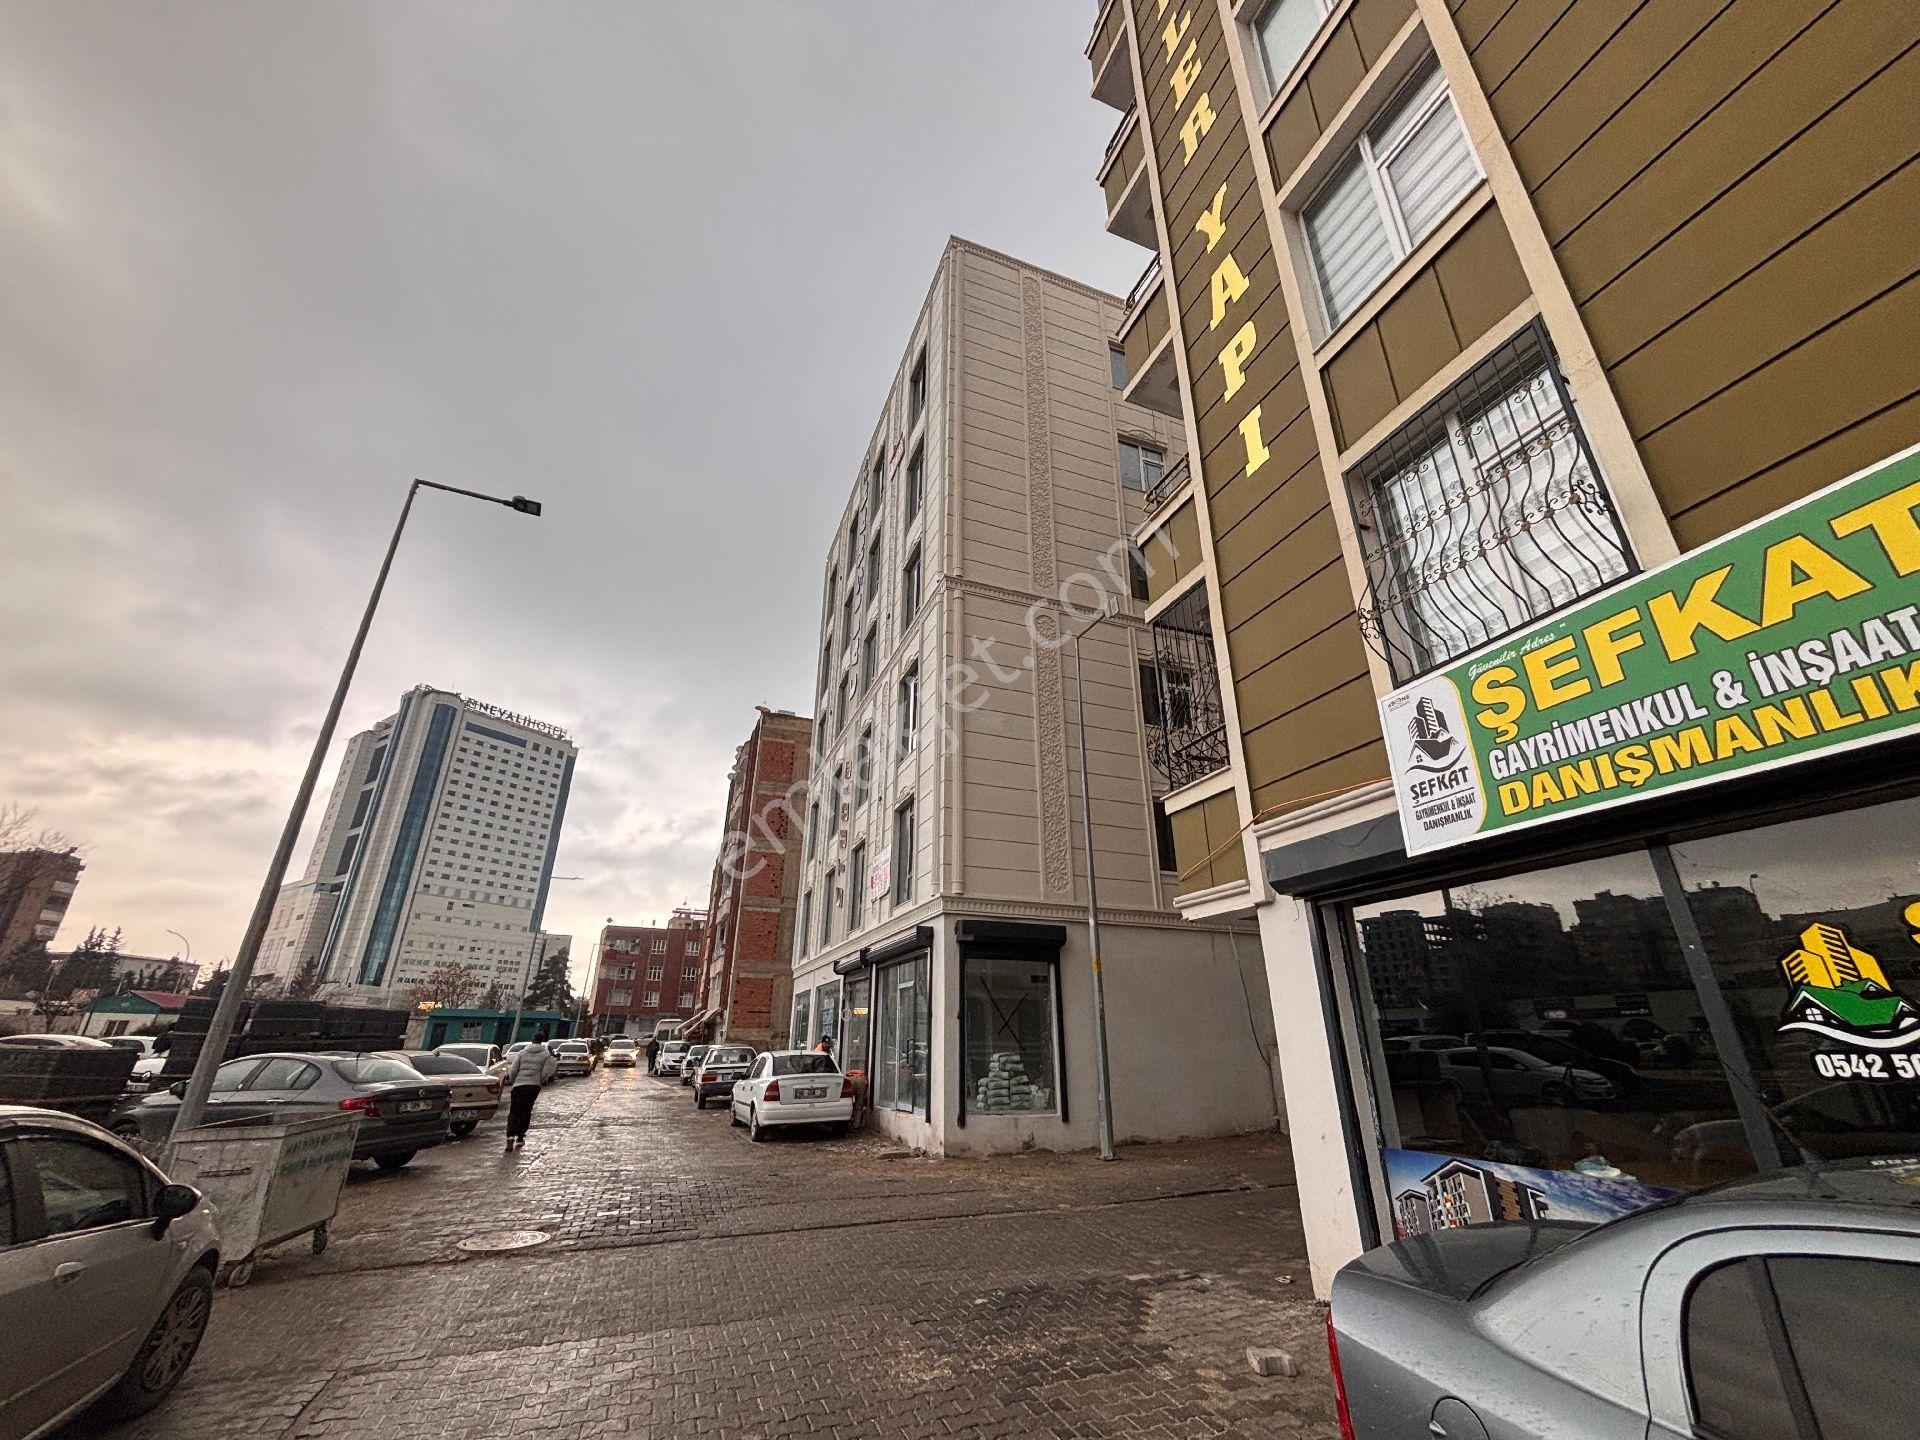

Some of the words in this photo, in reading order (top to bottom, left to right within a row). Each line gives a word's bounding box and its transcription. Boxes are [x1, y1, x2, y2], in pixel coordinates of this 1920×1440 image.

[1158, 0, 1216, 167] LER
[1195, 181, 1271, 478] YAPI
[1471, 480, 1920, 743] ŞEFKAT
[1520, 632, 1556, 655] Adres
[1489, 683, 1709, 781] GAYRİMENKUL
[1712, 669, 1749, 710] &
[1748, 605, 1920, 698] İNŞAAT
[1410, 766, 1469, 805] ŞEFKAT
[1415, 799, 1451, 821] GAYRİMENKUL
[1456, 792, 1476, 808] İNŞAAT
[1423, 808, 1473, 831] DANIŞMANLIK
[1814, 1053, 1890, 1078] 0542
